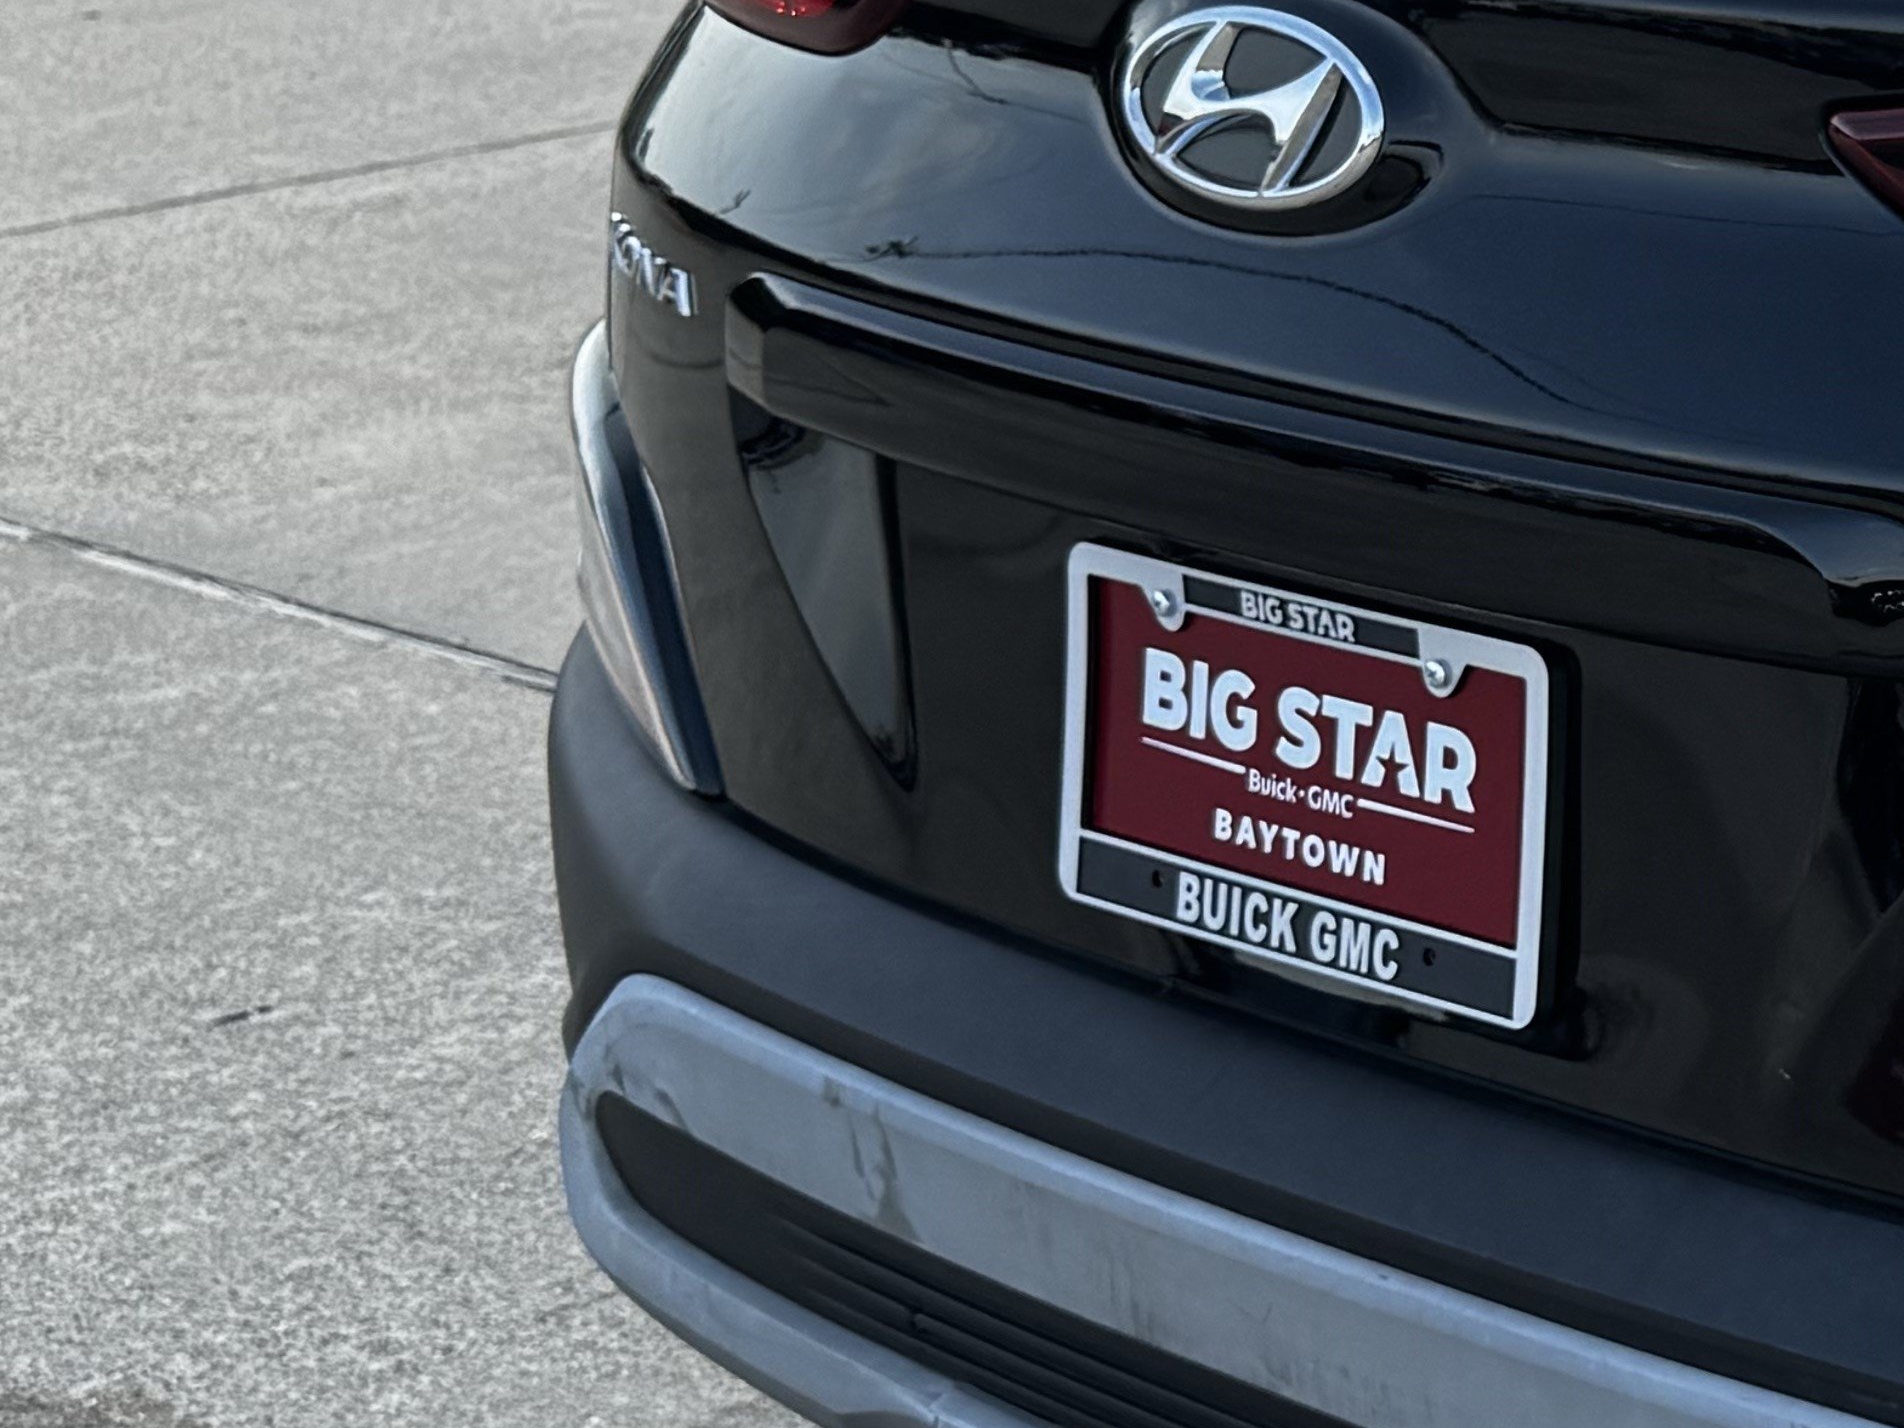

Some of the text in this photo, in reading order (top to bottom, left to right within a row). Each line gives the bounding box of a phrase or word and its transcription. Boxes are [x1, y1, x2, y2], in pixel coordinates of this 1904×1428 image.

[1240, 589, 1357, 645] BIG STAR
[1141, 646, 1478, 814] BIG STAR
[1212, 807, 1386, 886] BAYTOWN
[1175, 871, 1400, 982] BUICK GMC
